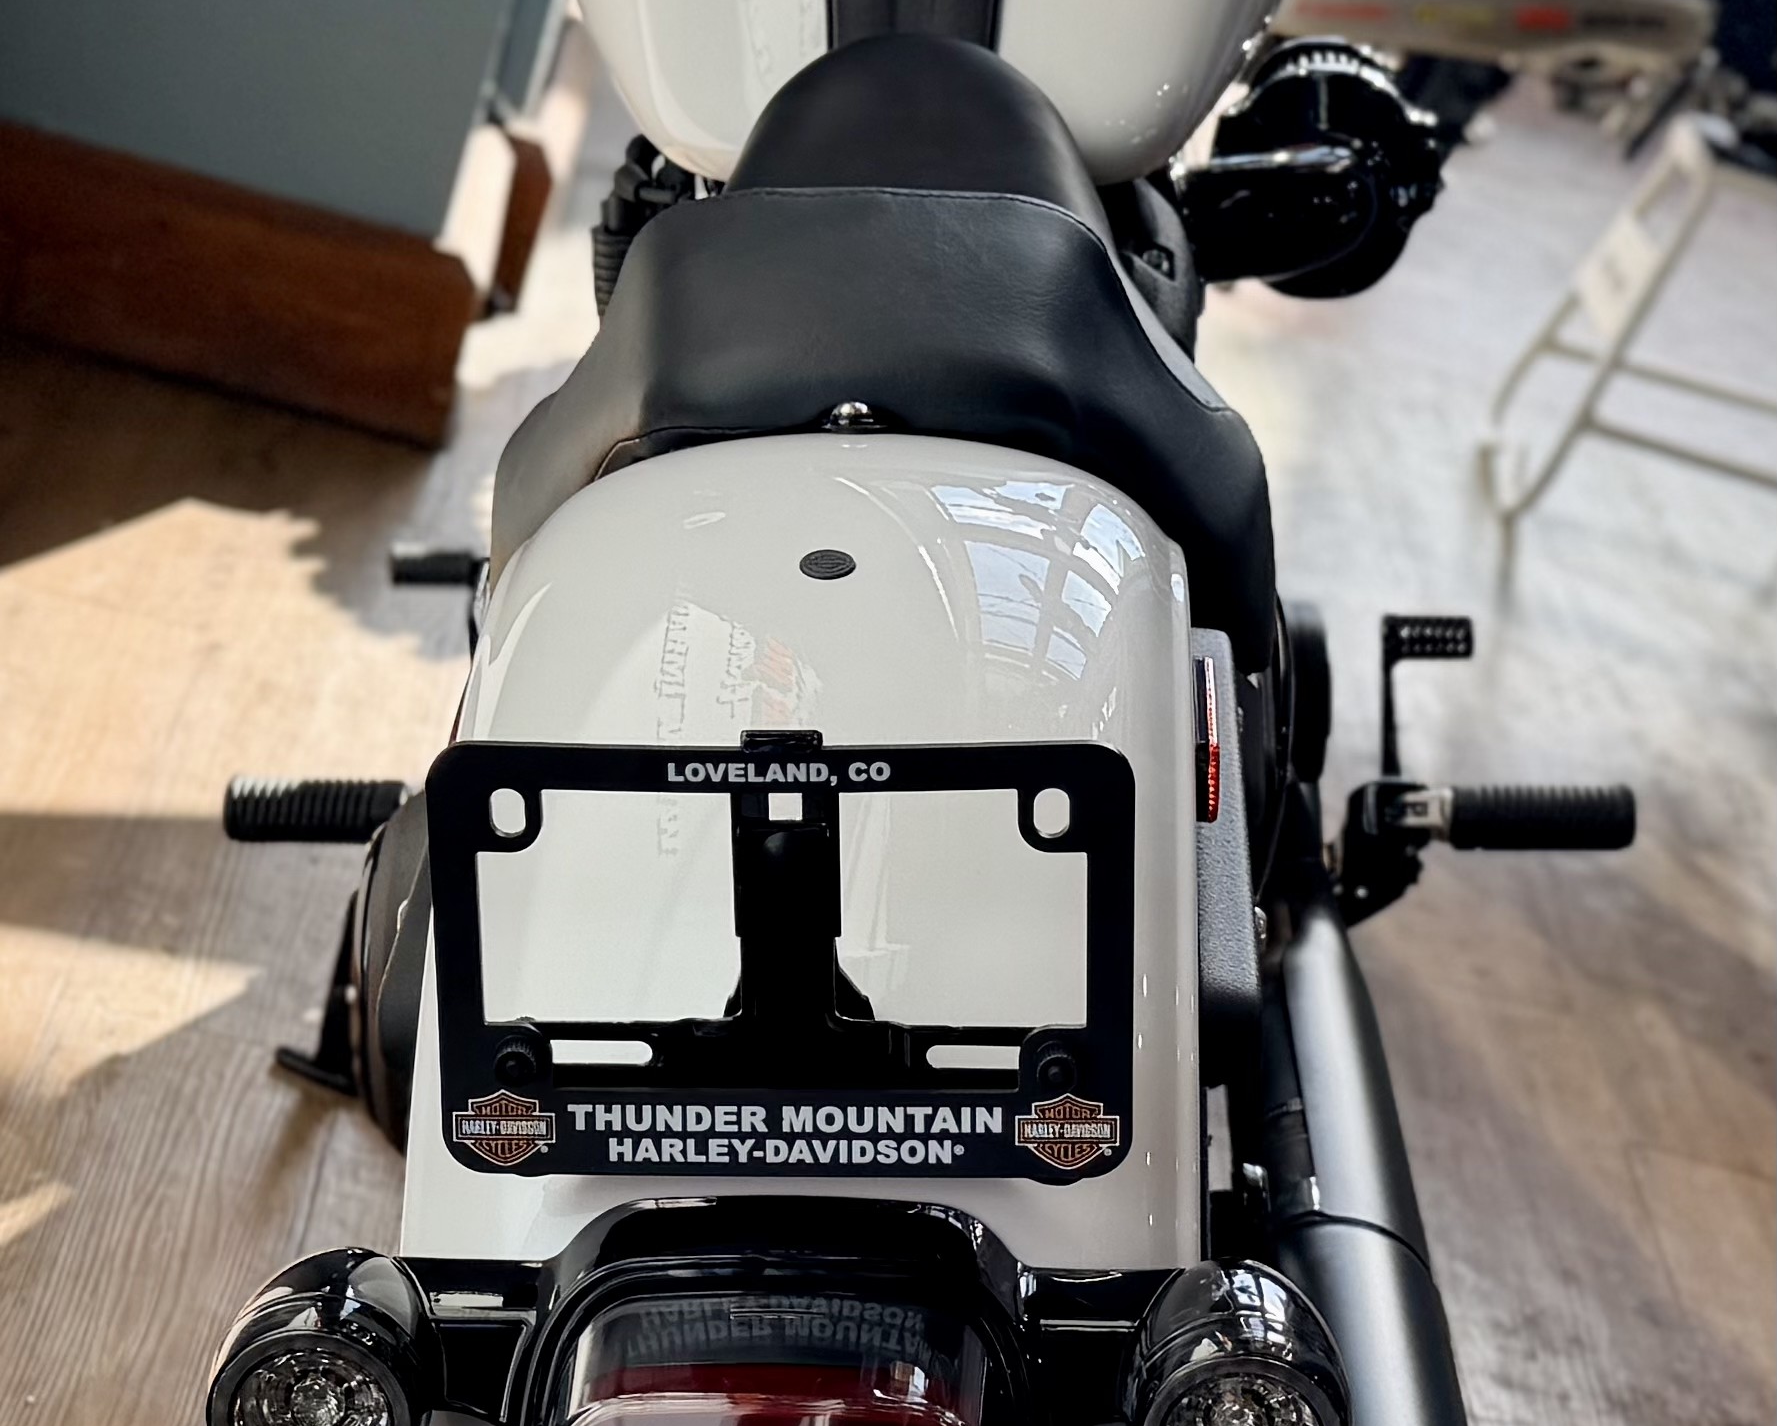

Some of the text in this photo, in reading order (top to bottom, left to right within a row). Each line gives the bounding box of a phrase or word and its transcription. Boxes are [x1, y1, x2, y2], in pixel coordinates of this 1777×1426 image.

[667, 762, 891, 786] LOVELAND, CO
[481, 1100, 527, 1115] MOTOR
[1045, 1103, 1091, 1119] MOTOR
[567, 1104, 1002, 1134] THUNDER MOUNTAIN
